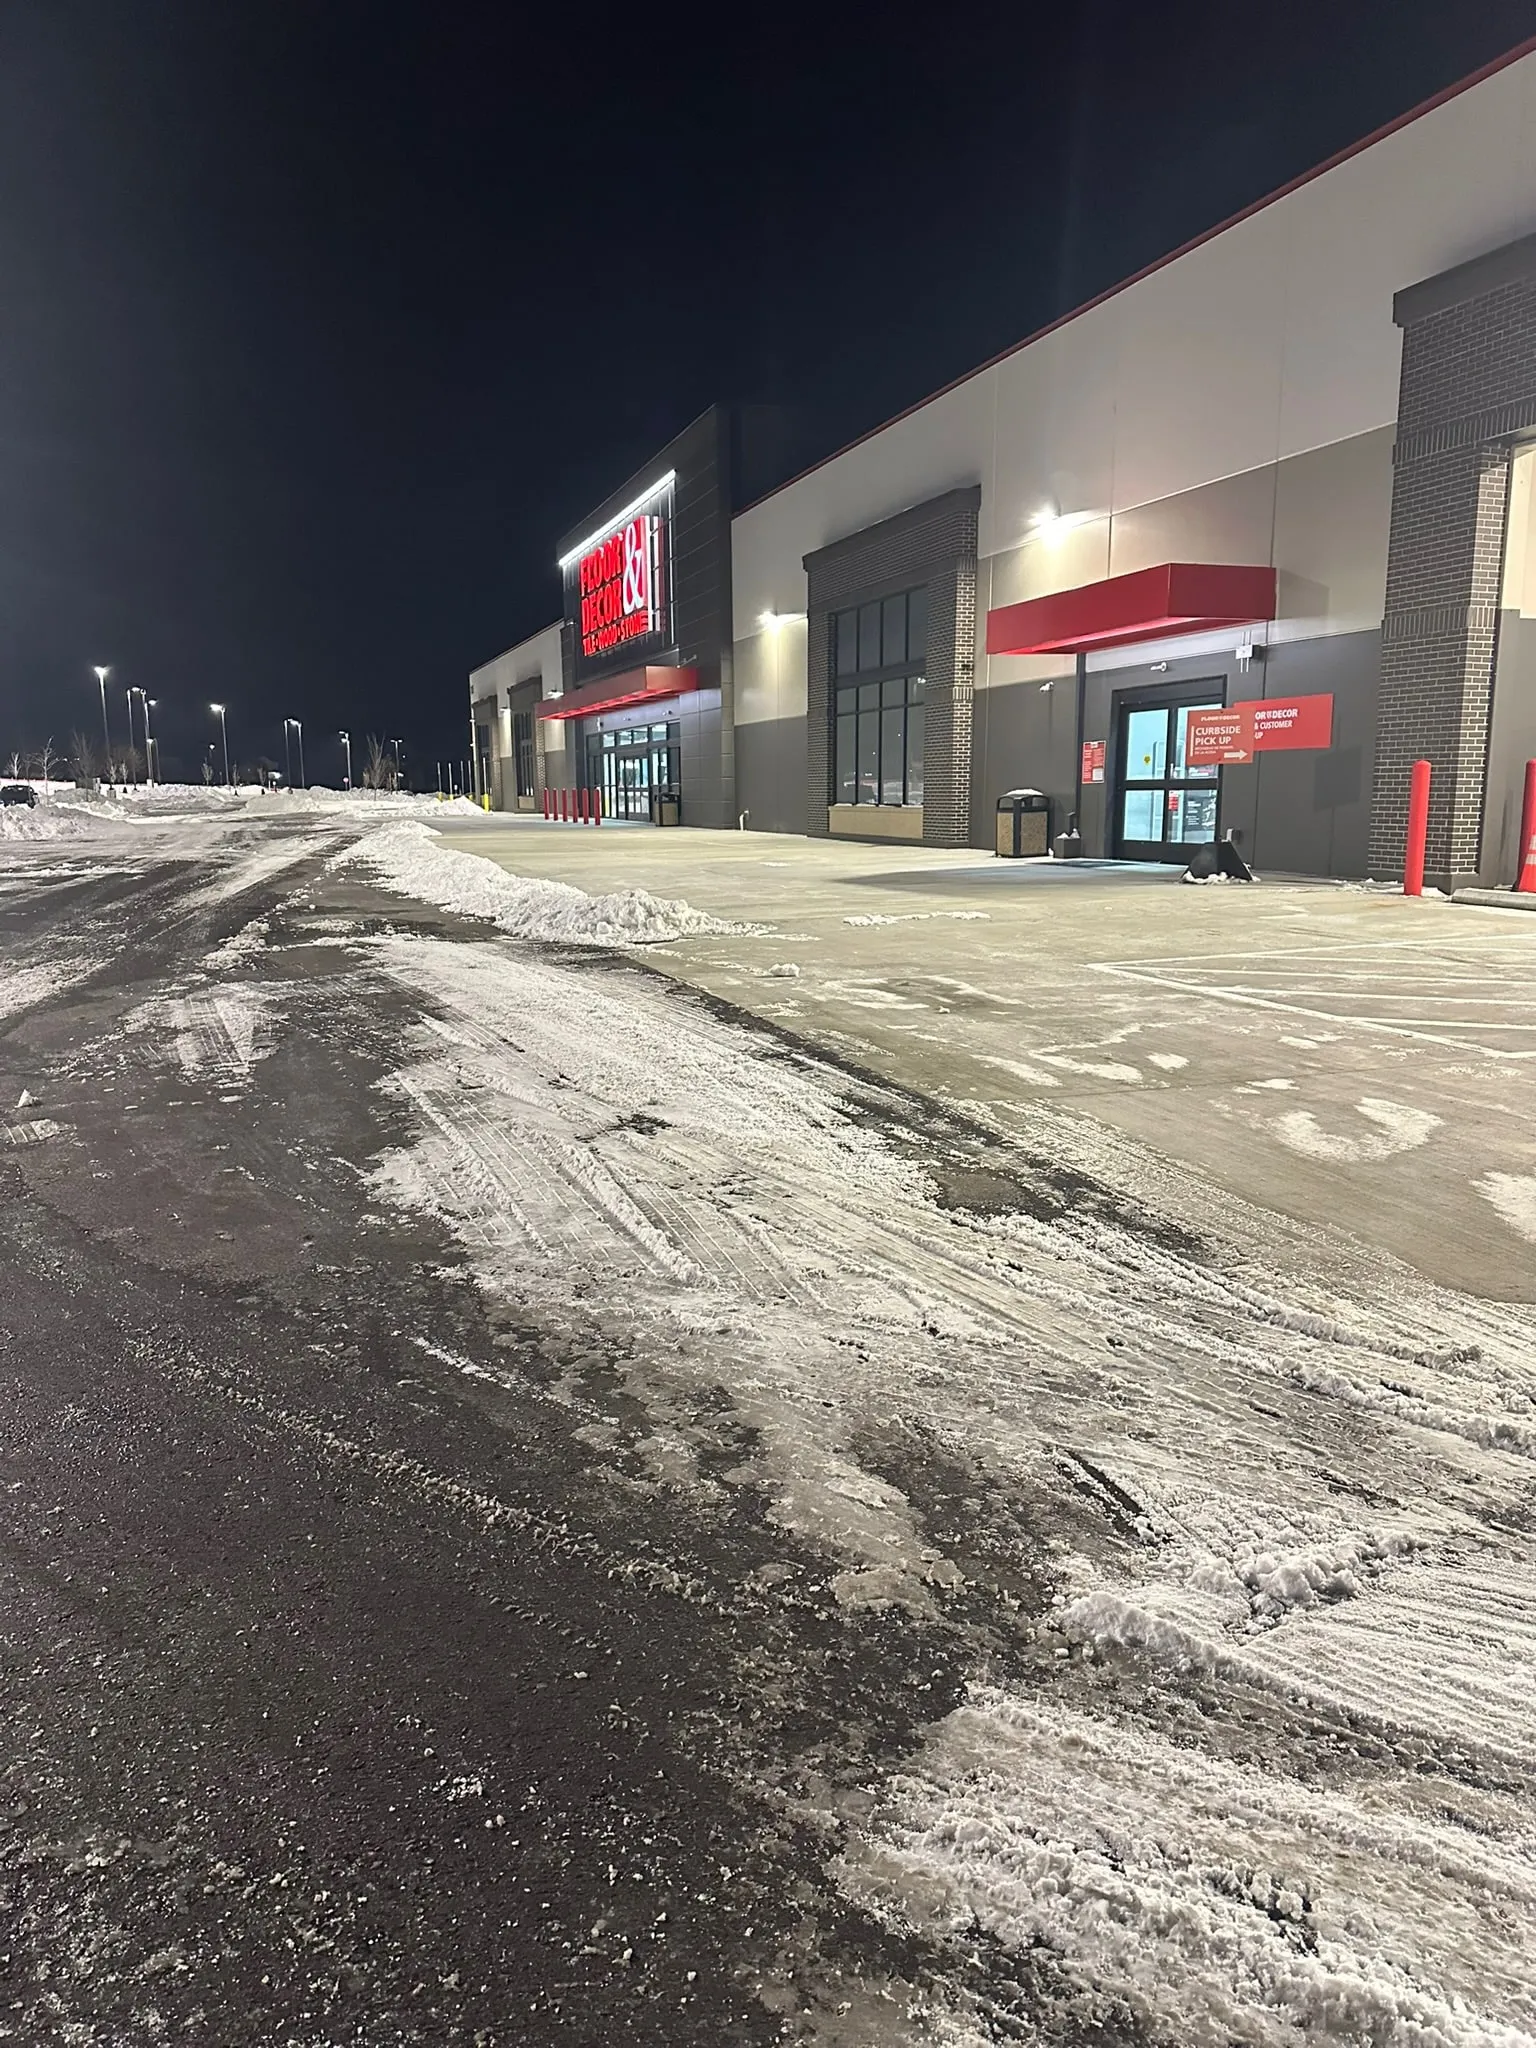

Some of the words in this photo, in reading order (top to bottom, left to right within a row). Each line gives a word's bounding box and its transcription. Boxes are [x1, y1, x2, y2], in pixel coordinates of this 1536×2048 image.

[580, 533, 624, 597] FLOOR
[623, 521, 644, 615] &
[581, 578, 622, 636] DECOR
[1272, 708, 1298, 719] DECOR
[1195, 725, 1241, 736] CURBSIDE
[1260, 720, 1293, 730] CUSTOMER
[1194, 736, 1217, 746] PICK
[1218, 736, 1232, 745] UP
